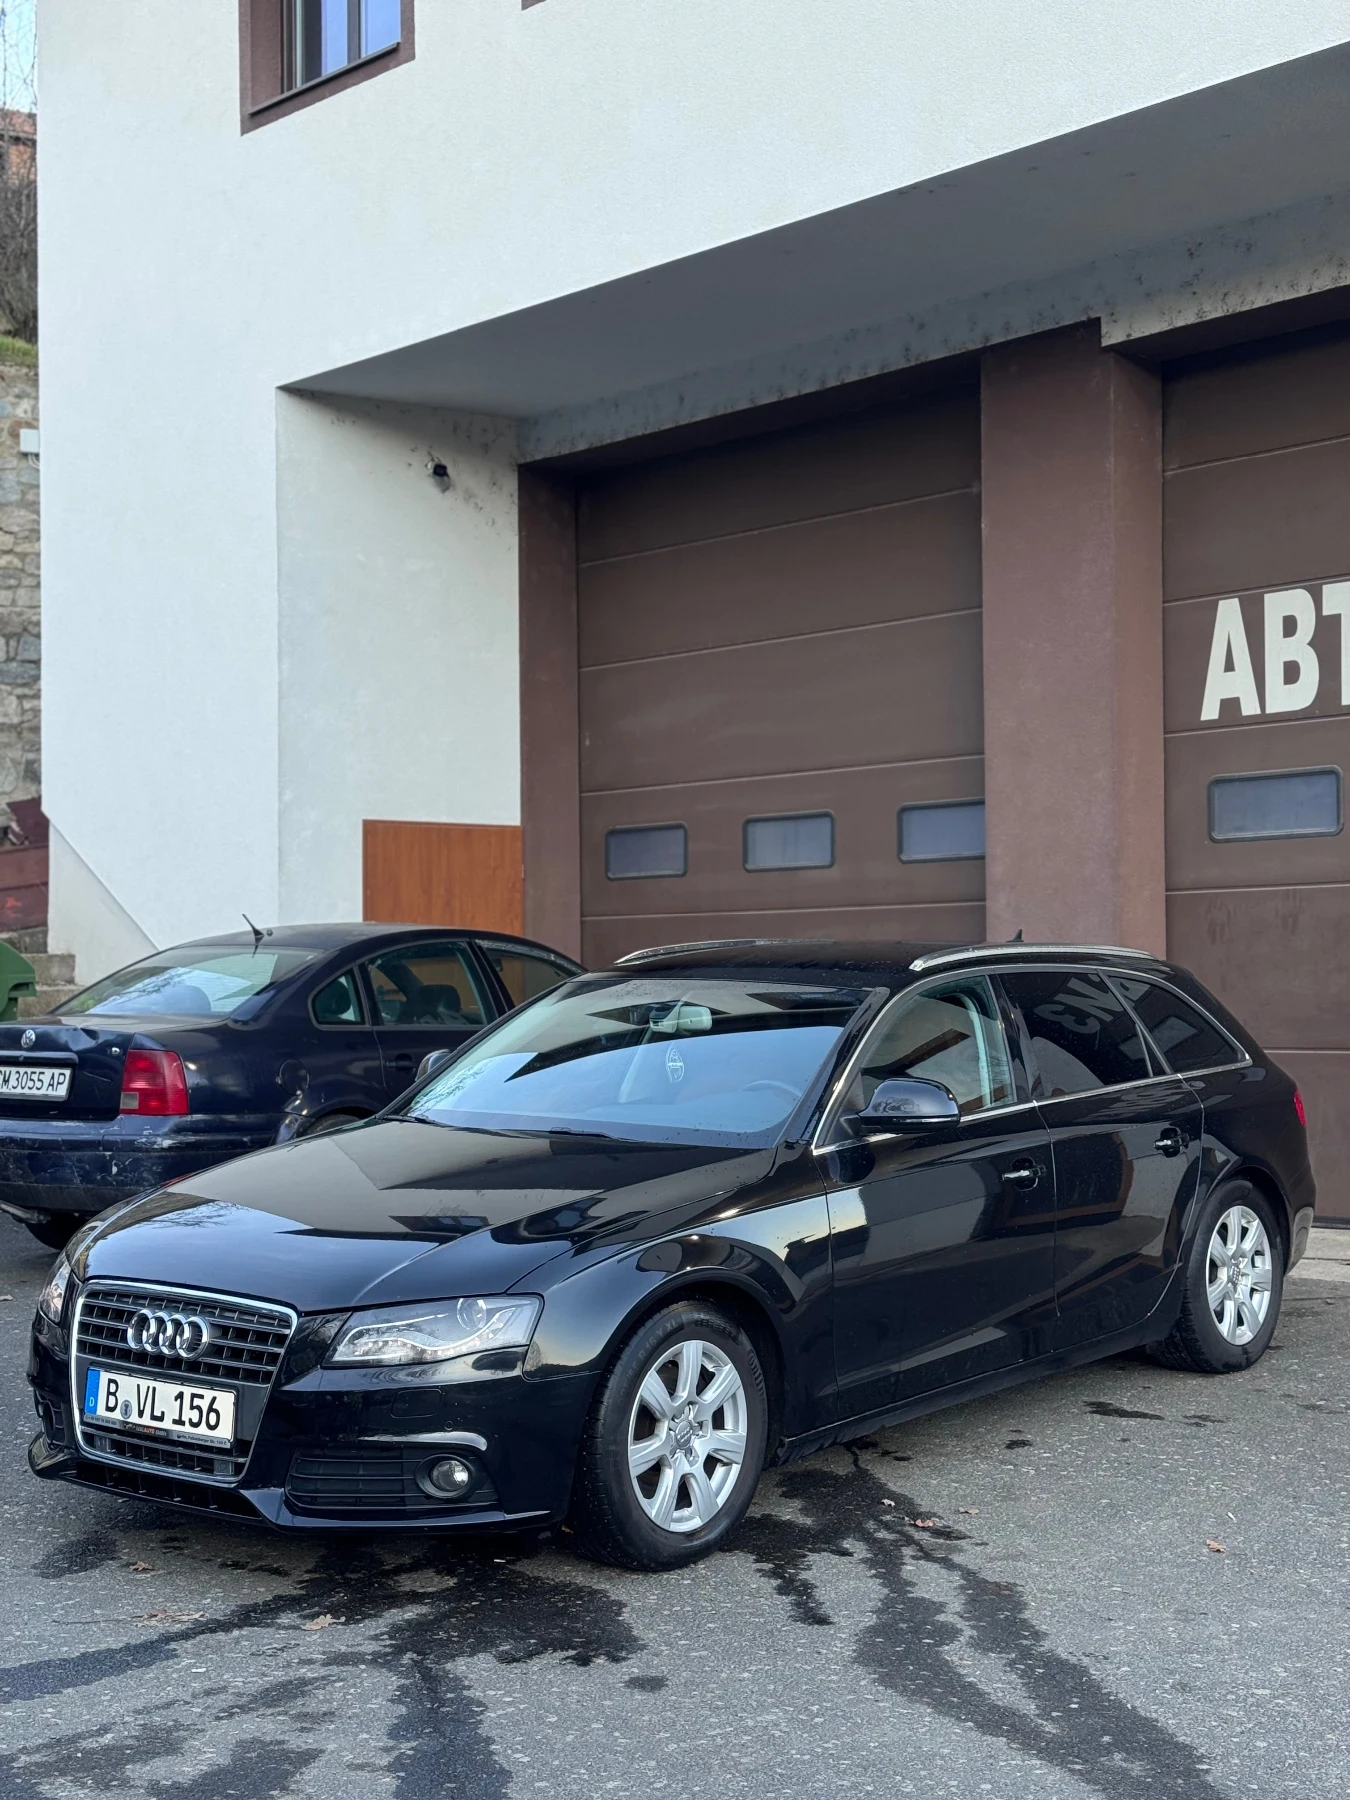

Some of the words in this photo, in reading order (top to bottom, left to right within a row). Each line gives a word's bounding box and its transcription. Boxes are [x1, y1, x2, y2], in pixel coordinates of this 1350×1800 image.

[0, 1069, 11, 1090] M
[12, 1070, 44, 1091] 3055
[46, 1071, 66, 1092] AP
[89, 1396, 94, 1407] D
[105, 1377, 119, 1413] B
[136, 1383, 165, 1423] VL
[172, 1390, 221, 1432] 156
